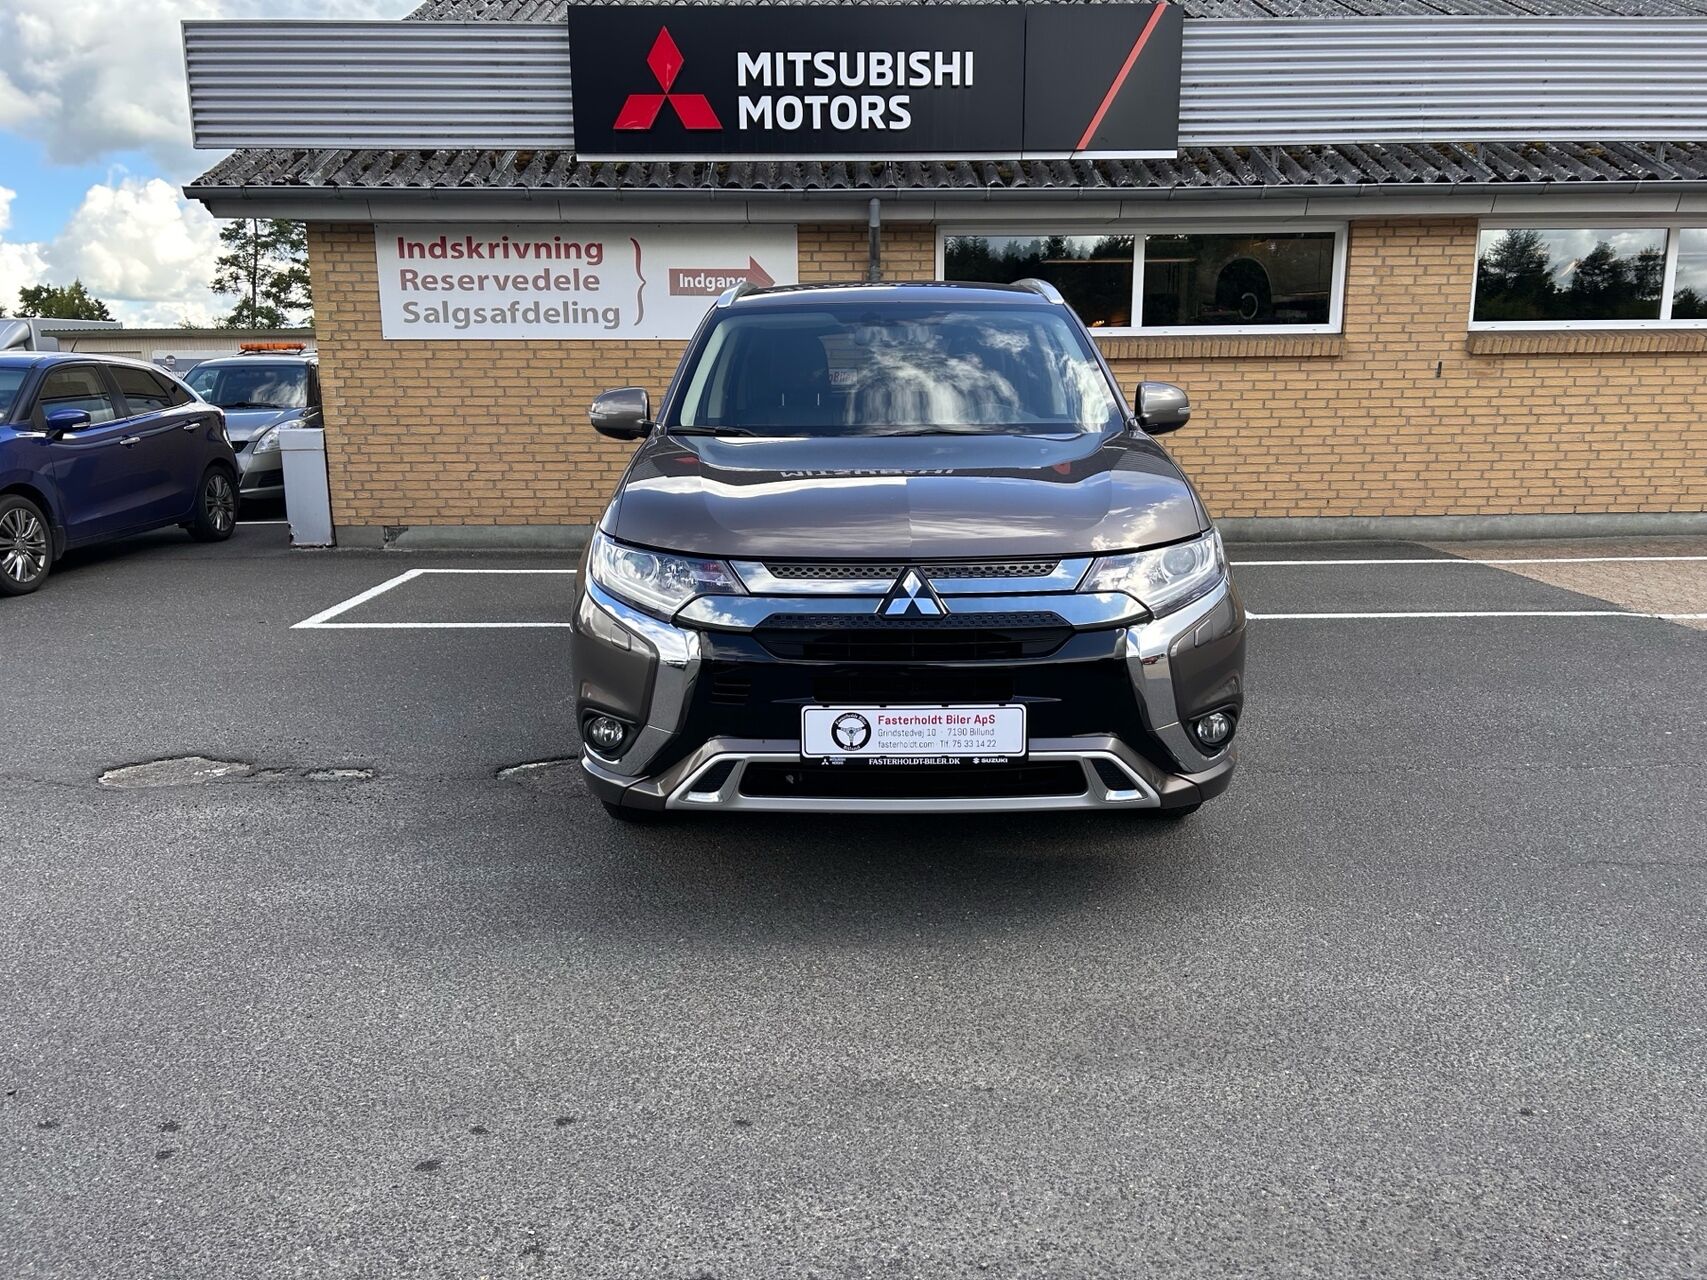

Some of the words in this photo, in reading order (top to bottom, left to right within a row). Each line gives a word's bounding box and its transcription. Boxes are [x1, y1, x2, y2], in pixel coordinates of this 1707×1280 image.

[737, 51, 974, 87] MITSUBISHI
[738, 95, 912, 130] MOTORS
[397, 236, 603, 266] Indskrivning
[400, 268, 601, 292] Reservedele
[402, 301, 621, 329] Salgsafdeling
[877, 728, 925, 738] Grindstedvej
[927, 728, 937, 737] 10
[947, 727, 968, 737] 7190
[969, 727, 995, 736] Billund
[878, 715, 943, 725] Fasterholdt
[946, 714, 971, 725] Biler
[974, 714, 996, 727] ApS
[952, 739, 962, 748] 75
[963, 739, 974, 748] 33
[975, 739, 985, 748] 14
[986, 739, 997, 748] 22
[868, 757, 961, 765] FASTERHOLDT-BILER.DK
